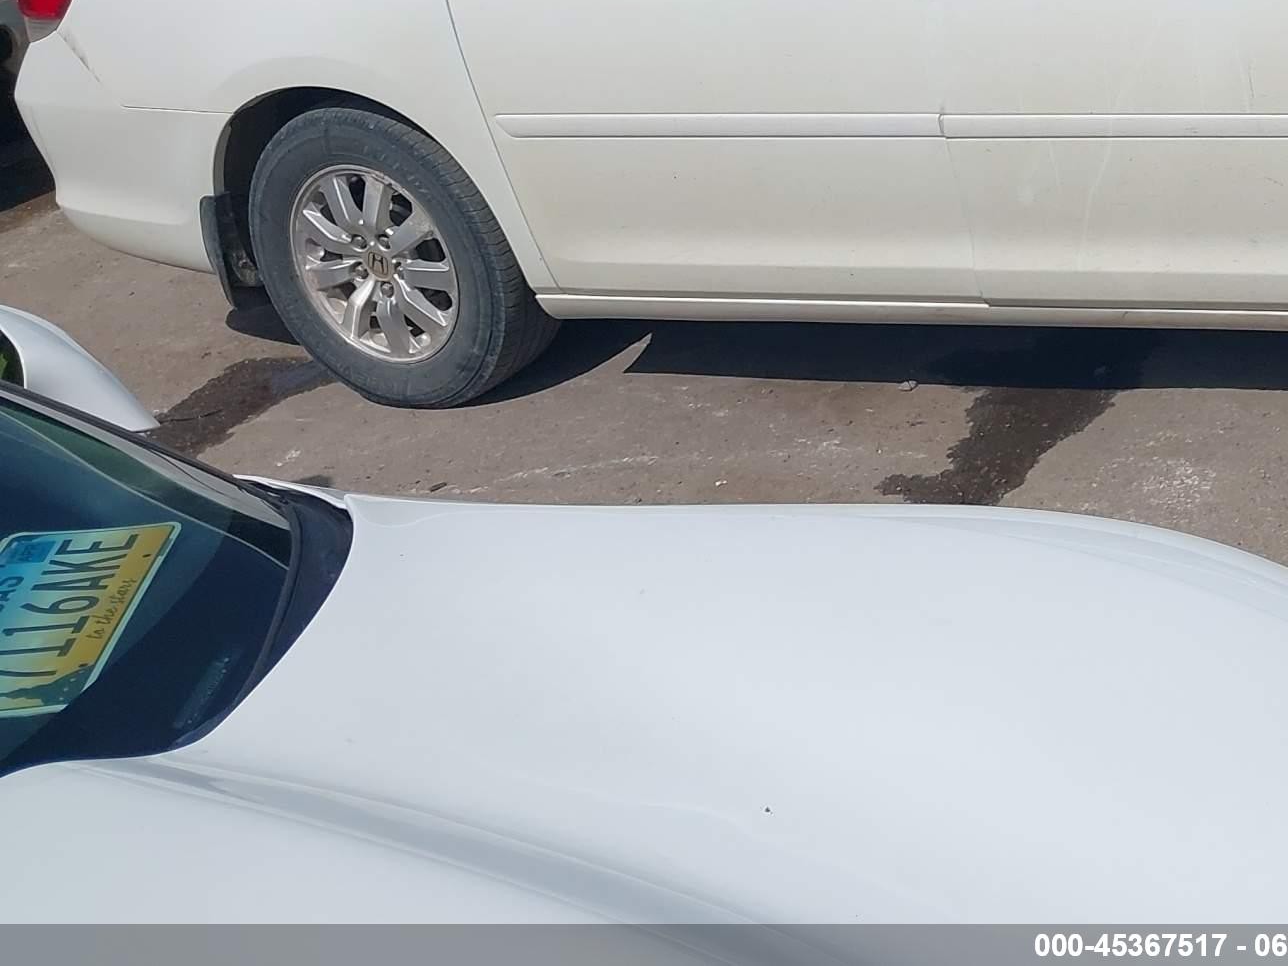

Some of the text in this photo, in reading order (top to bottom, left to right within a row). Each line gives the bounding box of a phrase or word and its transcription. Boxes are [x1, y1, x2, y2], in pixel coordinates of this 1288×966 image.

[86, 577, 138, 640] to the stars
